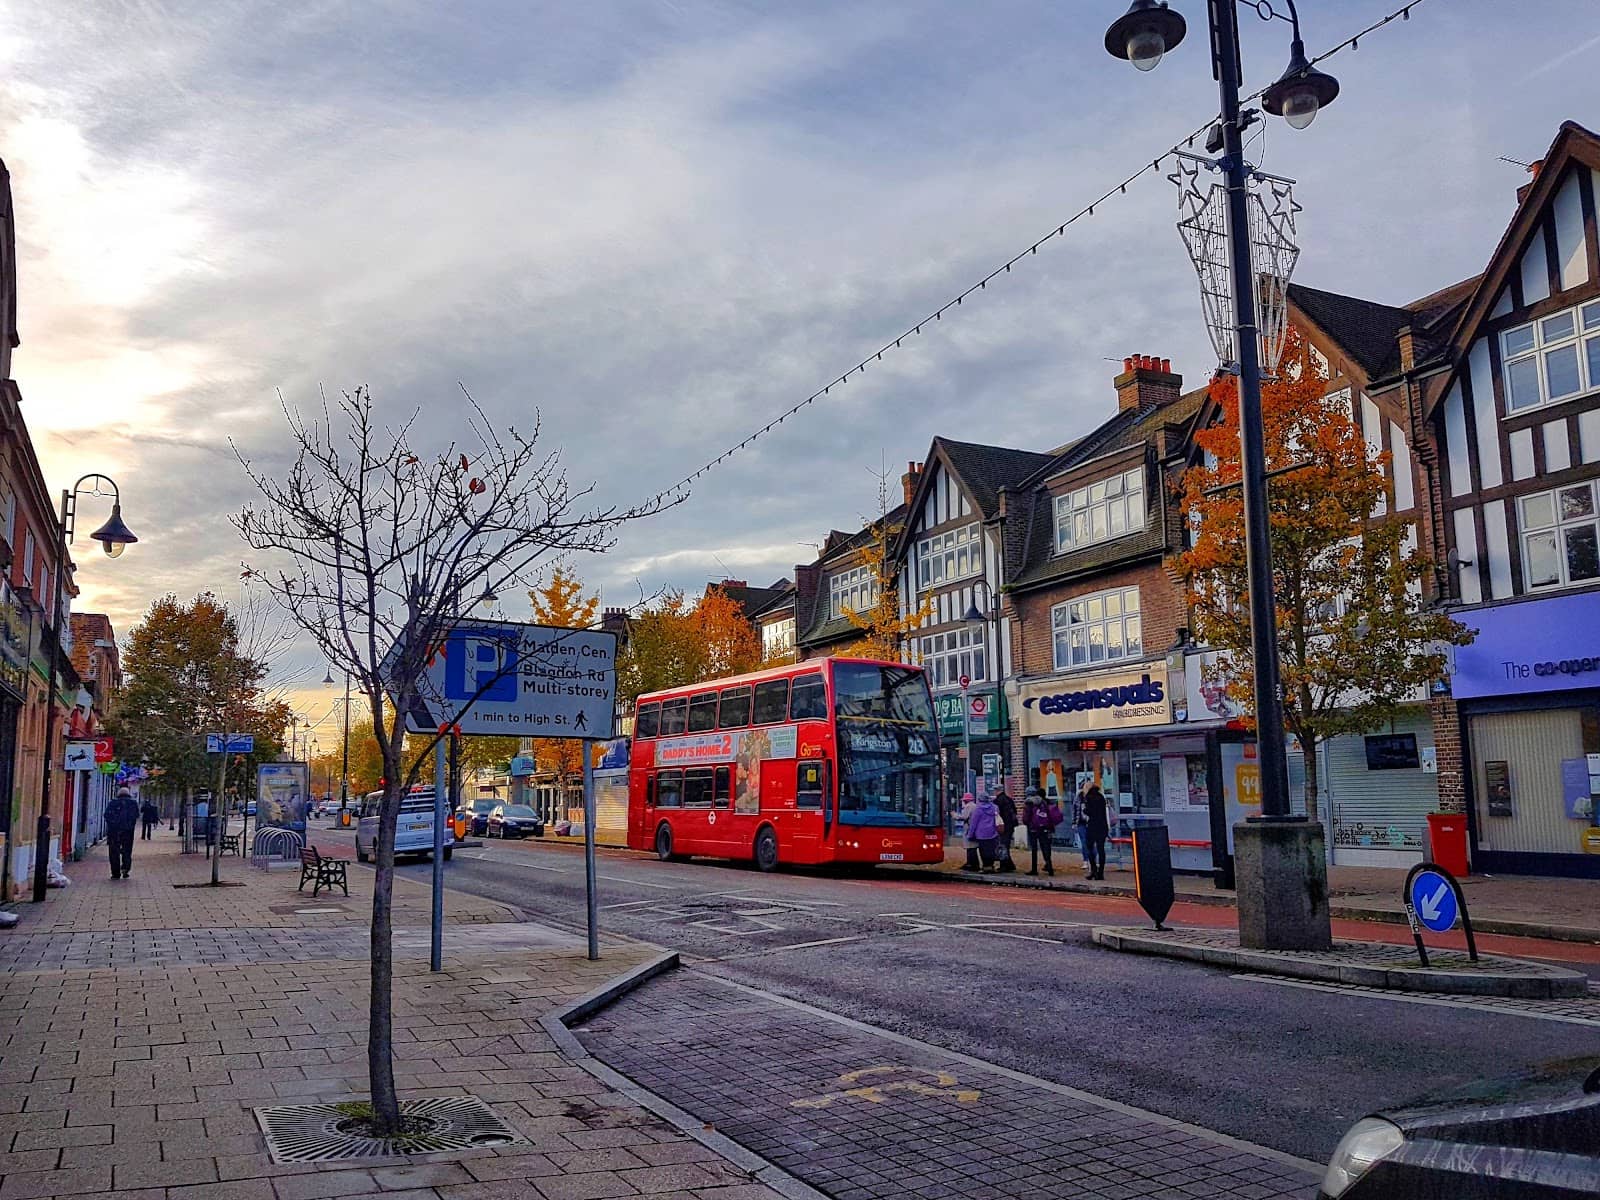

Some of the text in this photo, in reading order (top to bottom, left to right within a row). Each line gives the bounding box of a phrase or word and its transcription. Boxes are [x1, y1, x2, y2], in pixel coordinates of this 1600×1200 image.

[581, 644, 611, 660] Cen.
[587, 668, 605, 682] Rd
[1501, 661, 1530, 680] The
[523, 680, 609, 699] Multi-storey
[1038, 674, 1164, 715] essensuals
[474, 711, 570, 726] 1 min to High St.
[662, 747, 694, 760] DADDY'S
[696, 744, 721, 757] HOME
[722, 735, 732, 754] 2
[856, 734, 924, 755] Kingston 213
